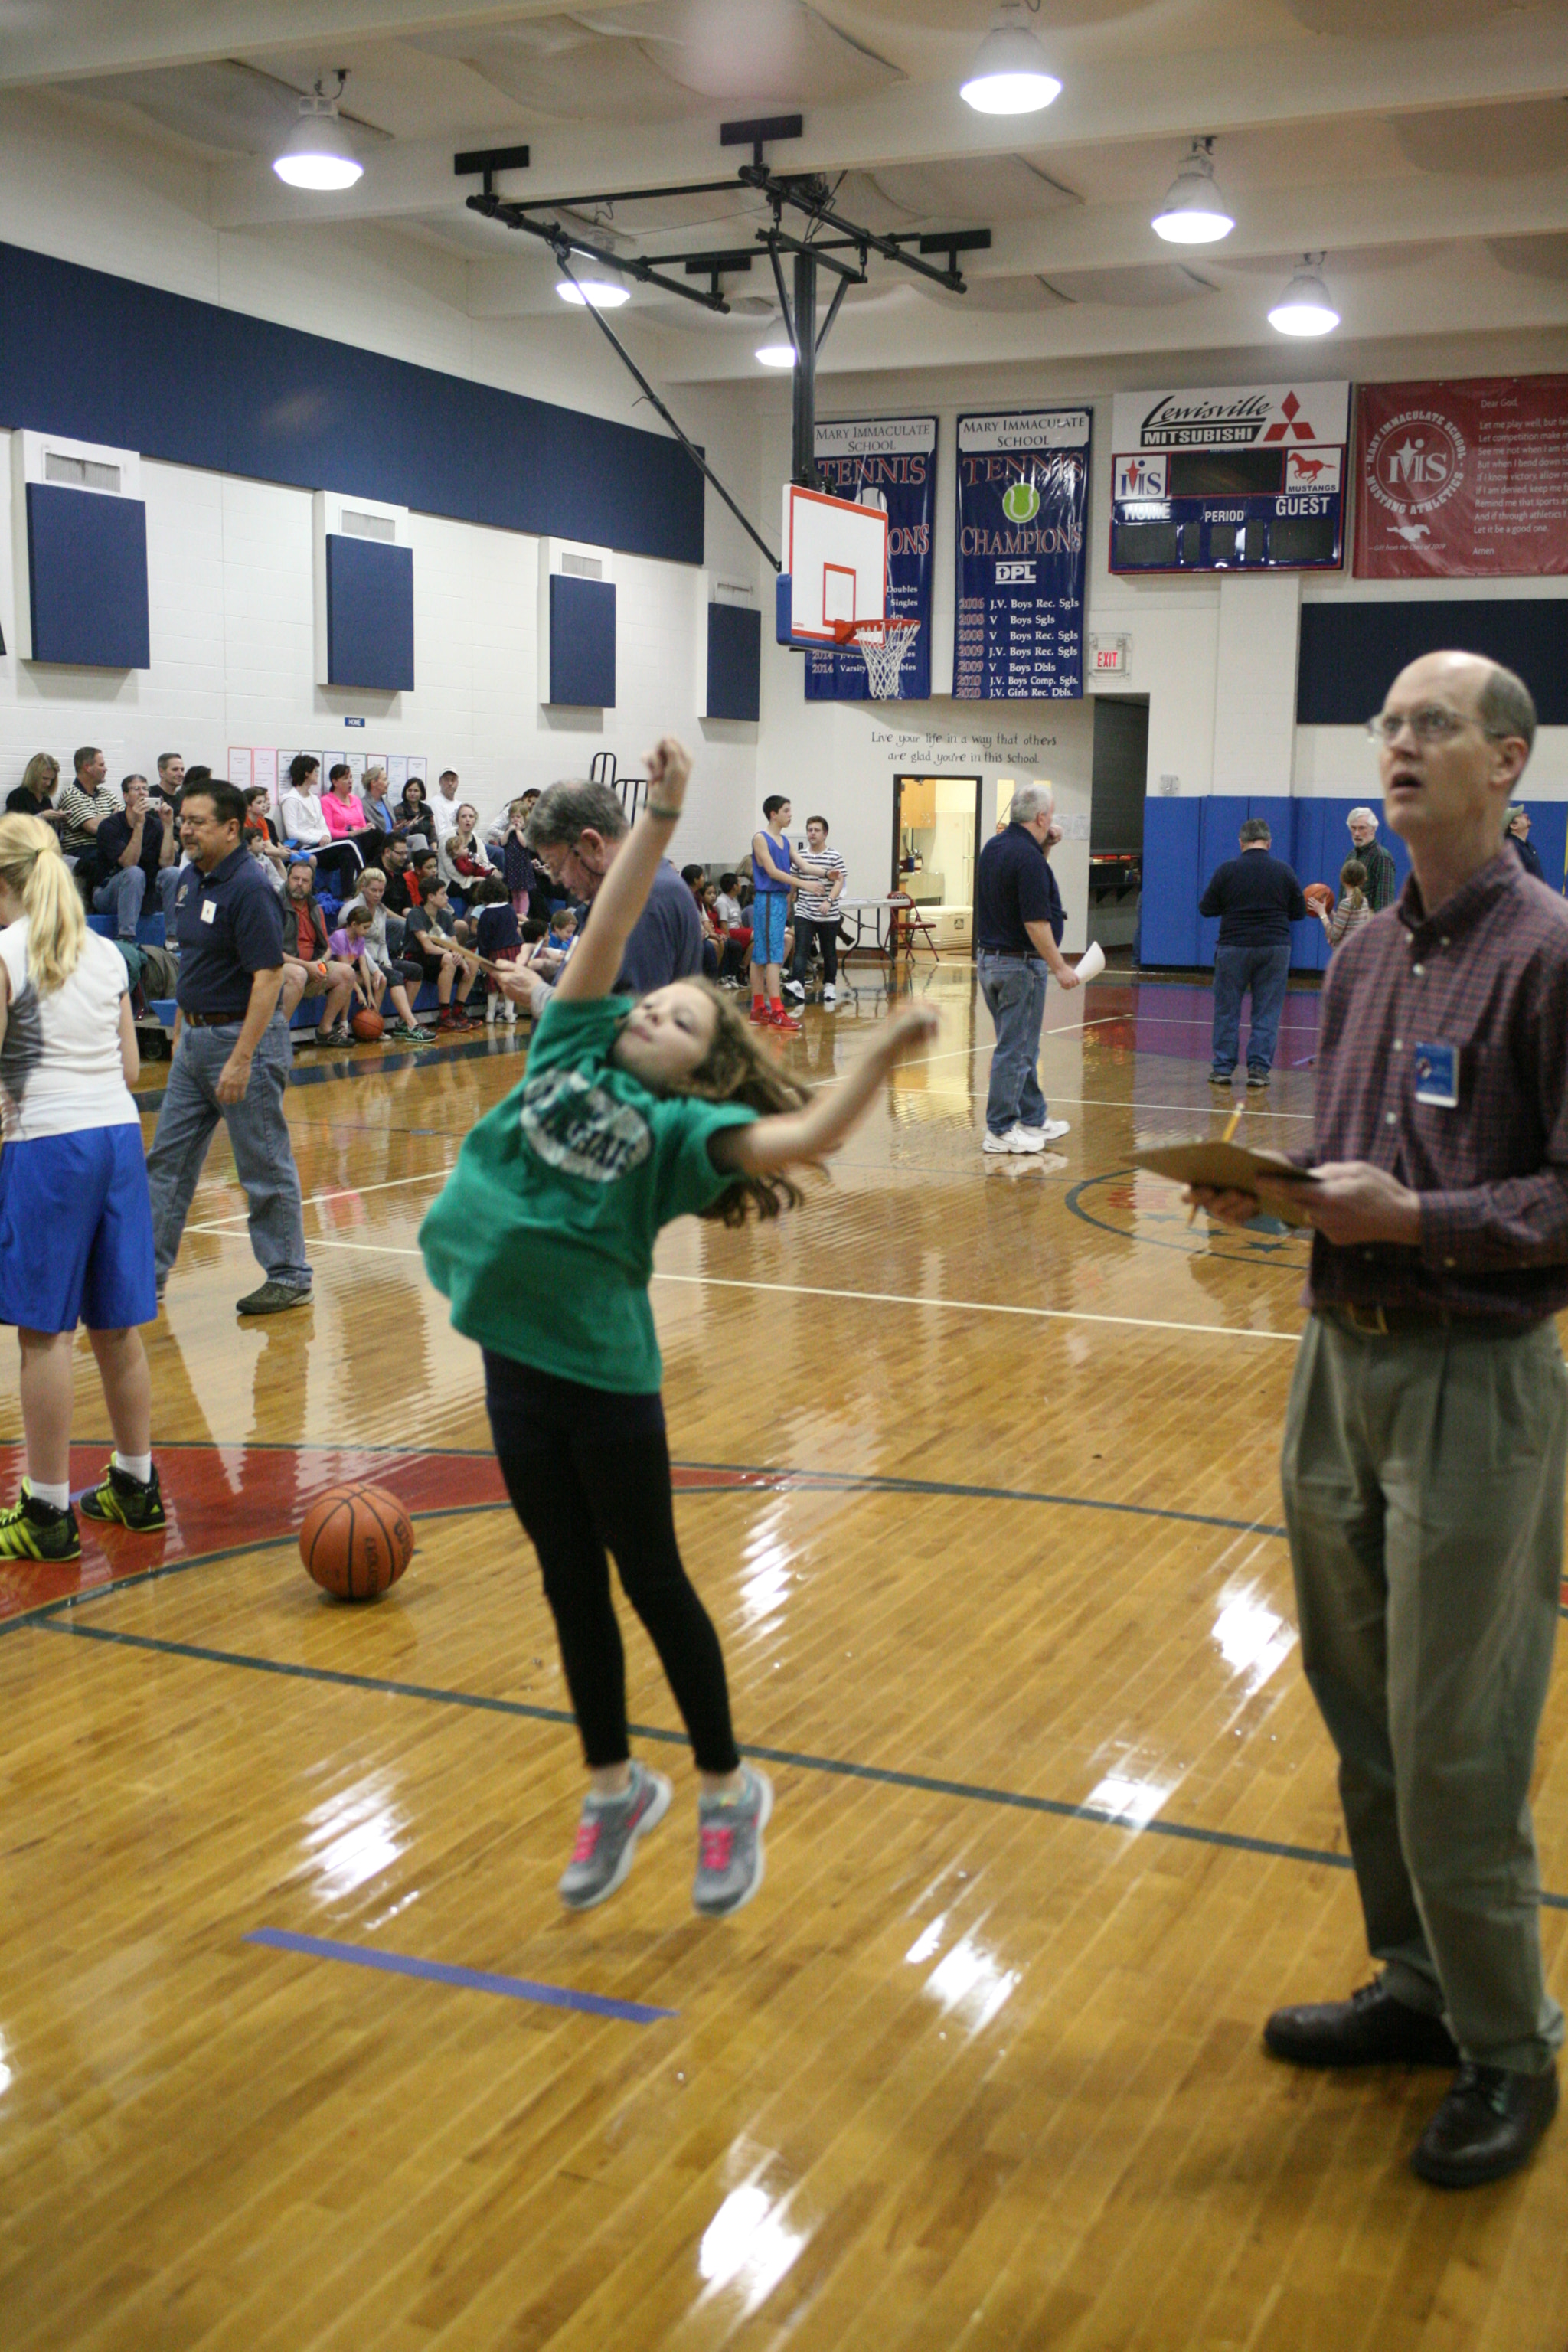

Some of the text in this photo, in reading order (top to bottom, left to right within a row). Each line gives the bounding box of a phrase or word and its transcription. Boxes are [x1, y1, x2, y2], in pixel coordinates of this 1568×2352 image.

[1481, 399, 1498, 408] Dear
[1141, 394, 1273, 429] Lewisville
[964, 416, 1085, 433] MARY IMMACULATE
[1479, 421, 1491, 430] Let
[1507, 419, 1522, 430] play
[816, 425, 930, 440] MARY IMMACULATE
[1144, 426, 1252, 444] MITSUBISHI
[1366, 410, 1466, 463] MARY IMMACULATE SCHOOL
[1478, 434, 1491, 443] Let
[1492, 433, 1538, 444] competition
[848, 440, 896, 452] SCHOOL
[998, 436, 1049, 447] SCHOOL
[1518, 458, 1537, 466] bend
[1539, 457, 1560, 466] down
[818, 456, 926, 486] TENNIS
[962, 453, 1083, 486] TENNIS
[1288, 484, 1336, 493] MUSTANGS
[1366, 472, 1464, 514] MUSTANG ATHLETICS
[1276, 497, 1330, 516] GUEST
[1204, 510, 1244, 523] PERIOD
[1475, 511, 1490, 521] And
[1498, 510, 1527, 522] through
[1474, 525, 1485, 534] Let
[1511, 523, 1531, 535] good
[961, 522, 1082, 556] CHAMPIONS
[1472, 547, 1494, 555] Amen
[995, 565, 1037, 580] DPL
[890, 598, 918, 609] Singles
[990, 599, 1007, 611] J.V.
[1011, 599, 1032, 611] Boys
[1036, 599, 1055, 608] Rec.
[1059, 598, 1080, 609] Sgls
[990, 616, 998, 625] V
[1010, 615, 1032, 626] Boys
[1035, 614, 1055, 626] Sgls
[989, 632, 997, 640] V
[1010, 631, 1031, 642] Boys
[1035, 631, 1054, 640] Rec.
[1058, 630, 1078, 642] Sgls
[988, 647, 1005, 658] J.V.
[1009, 646, 1031, 658] Boys
[1035, 646, 1054, 655] Rec.
[1057, 646, 1078, 658] Sgls
[1097, 652, 1118, 668] EXIT
[812, 663, 834, 674] 2014
[840, 664, 866, 674] Varsity
[988, 663, 996, 672] V
[1009, 662, 1031, 674] Boys
[1034, 662, 1056, 671] Dbls
[989, 676, 1004, 687] J.V.
[1008, 676, 1027, 687] Boys
[1030, 675, 1056, 688] Comp.
[1059, 675, 1078, 687] Sgls.
[989, 688, 1004, 699] J.V.
[1008, 688, 1028, 697] Girls
[1031, 688, 1048, 697] Rec.
[1052, 688, 1073, 697] Dbls.
[871, 731, 1057, 749] Live your life in a way that others
[887, 751, 1040, 766] are glad you're in this school.
